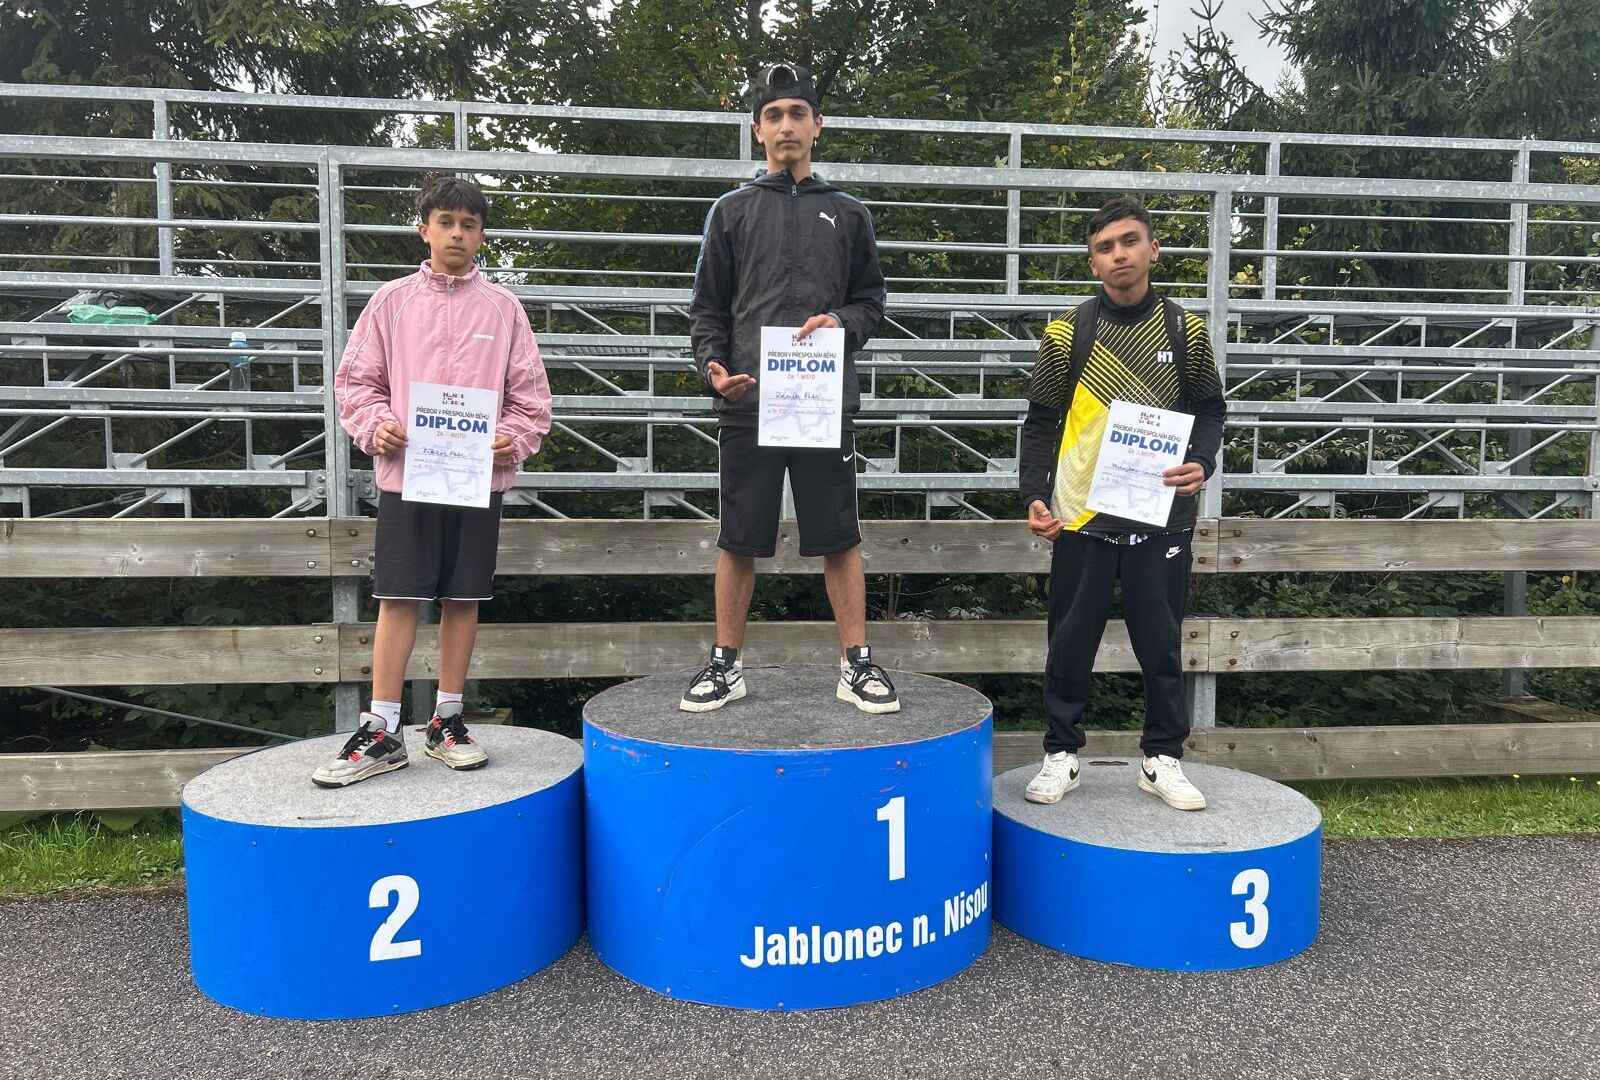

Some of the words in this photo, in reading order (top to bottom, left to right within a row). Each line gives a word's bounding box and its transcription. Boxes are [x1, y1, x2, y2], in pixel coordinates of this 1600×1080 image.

[767, 358, 836, 373] DIPLOM
[415, 413, 488, 434] DIPLOM
[1109, 430, 1179, 456] DIPLOM
[876, 796, 906, 881] 1
[367, 874, 423, 962] 2
[740, 924, 903, 969] Jablonec
[912, 914, 936, 947] n.
[944, 880, 989, 937] Nisou
[1229, 868, 1271, 949] 3
